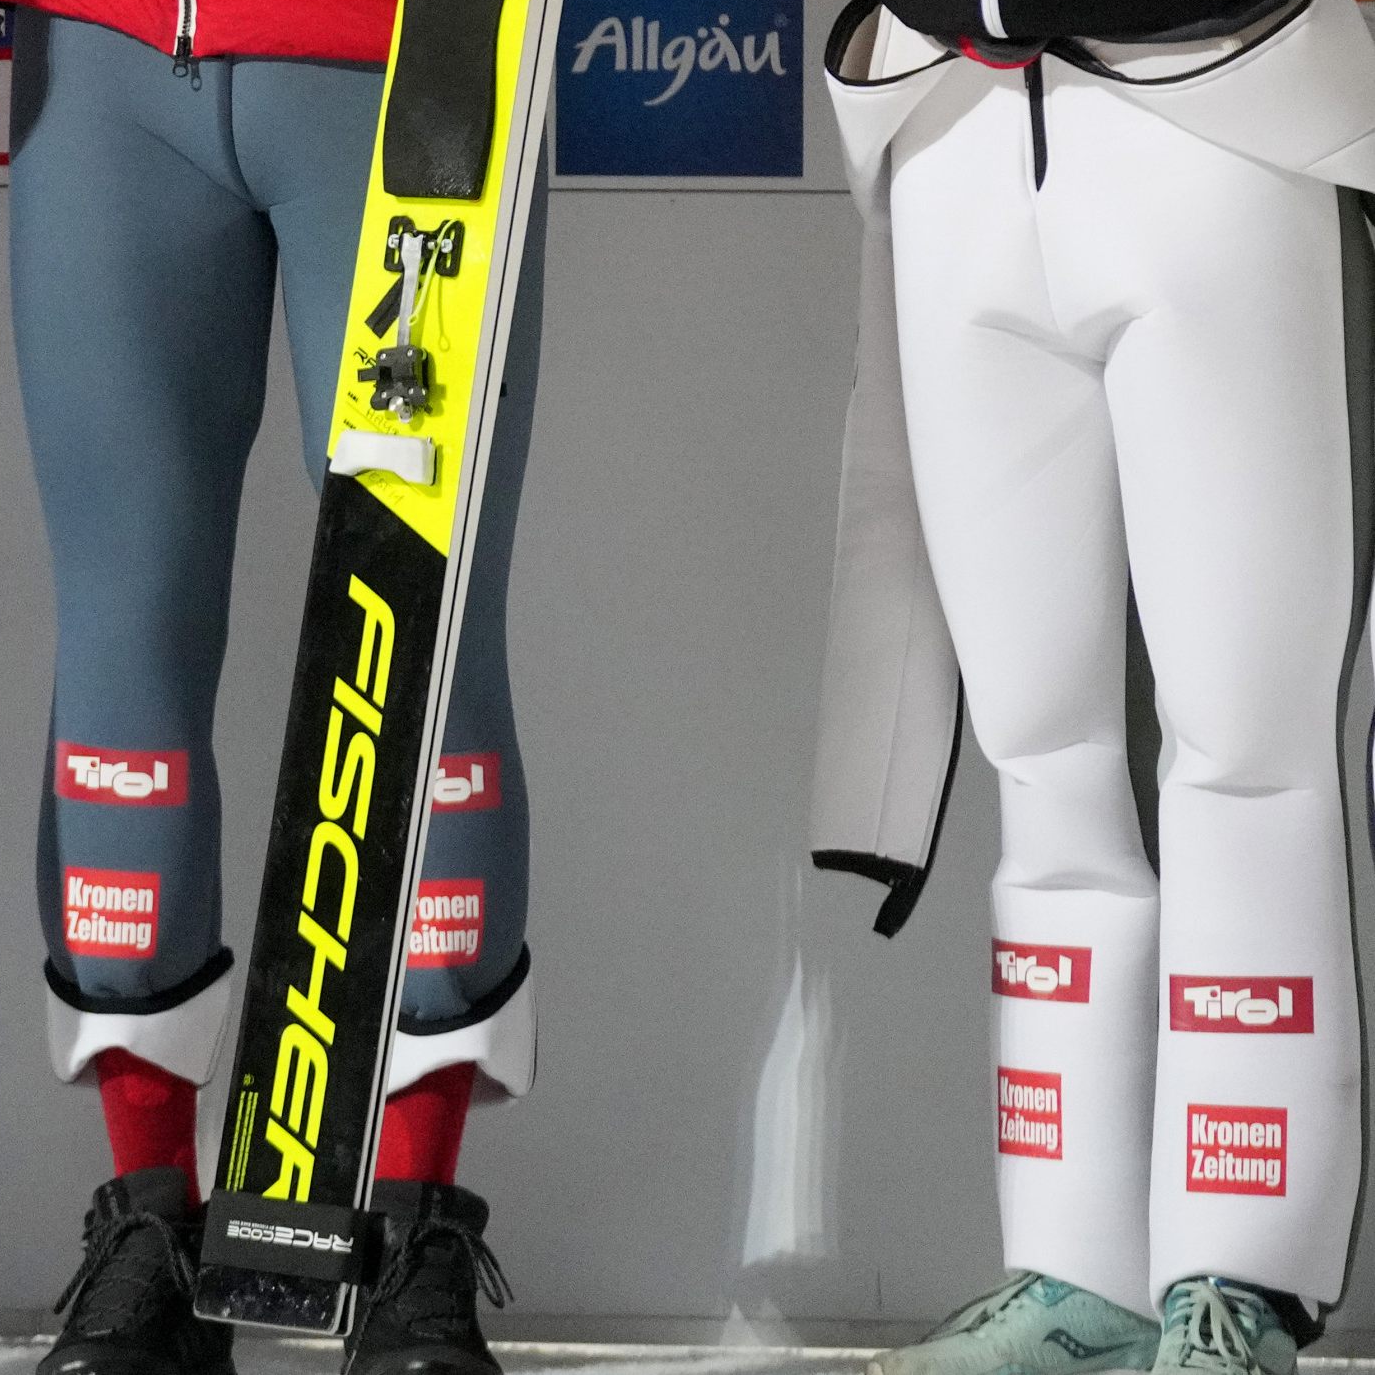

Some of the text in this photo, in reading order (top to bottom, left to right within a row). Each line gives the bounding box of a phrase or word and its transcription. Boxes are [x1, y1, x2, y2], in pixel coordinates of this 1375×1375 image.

[571, 14, 787, 107] Allgäu
[67, 755, 169, 799] Tirol
[68, 875, 154, 911] Kronen
[262, 573, 396, 1204] FISCHER
[67, 911, 152, 949] Zeitung
[409, 923, 479, 955] eitung
[996, 951, 1073, 993] Tirol
[1183, 985, 1294, 1025] Tirol
[1000, 1077, 1058, 1114] Kronen
[1000, 1112, 1058, 1150] Zeitung
[1191, 1113, 1282, 1148] Kronen
[1191, 1149, 1282, 1187] Zeitung
[227, 1224, 354, 1254] RACECODE
